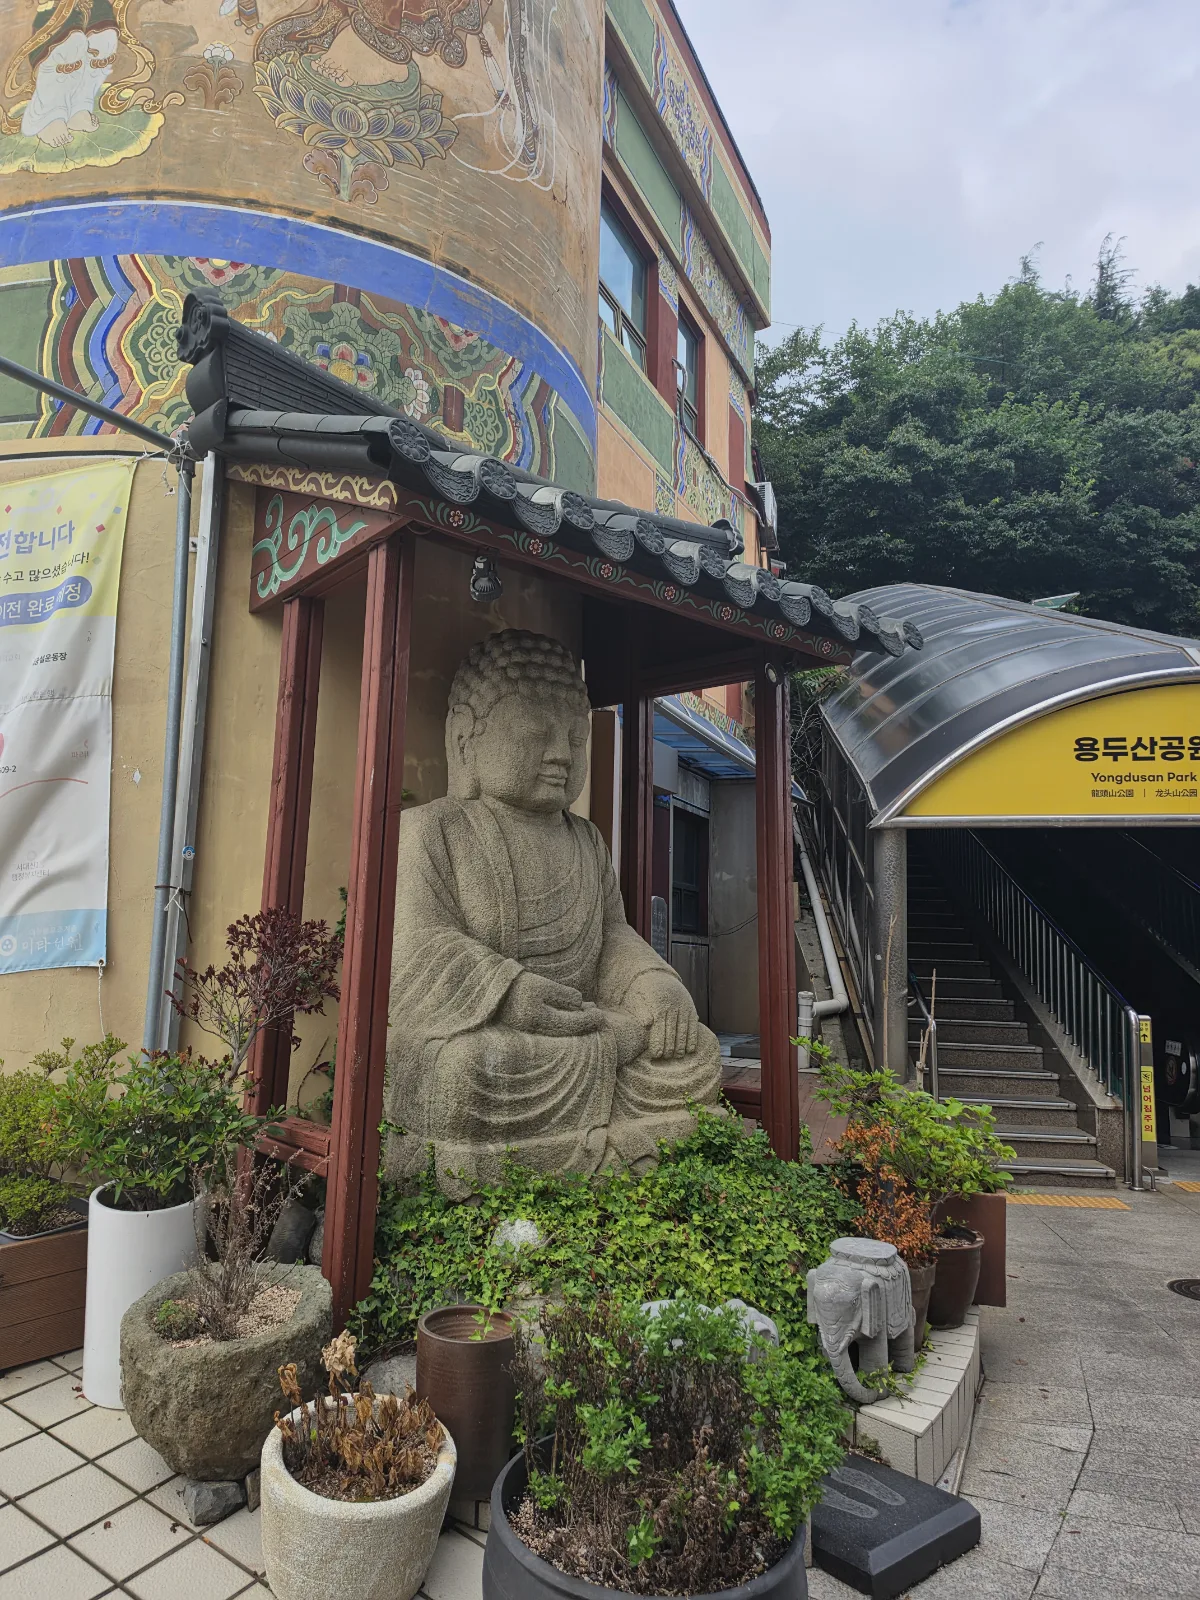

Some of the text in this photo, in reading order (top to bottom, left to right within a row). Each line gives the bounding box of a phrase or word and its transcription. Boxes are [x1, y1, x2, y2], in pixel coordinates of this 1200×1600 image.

[3, 552, 90, 584] 수고 많으셨습니다!
[27, 596, 55, 618] 완료
[0, 765, 17, 774] 09-2
[1091, 772, 1198, 785] Yongdusan Park
[1155, 788, 1198, 798] 龙头山公园
